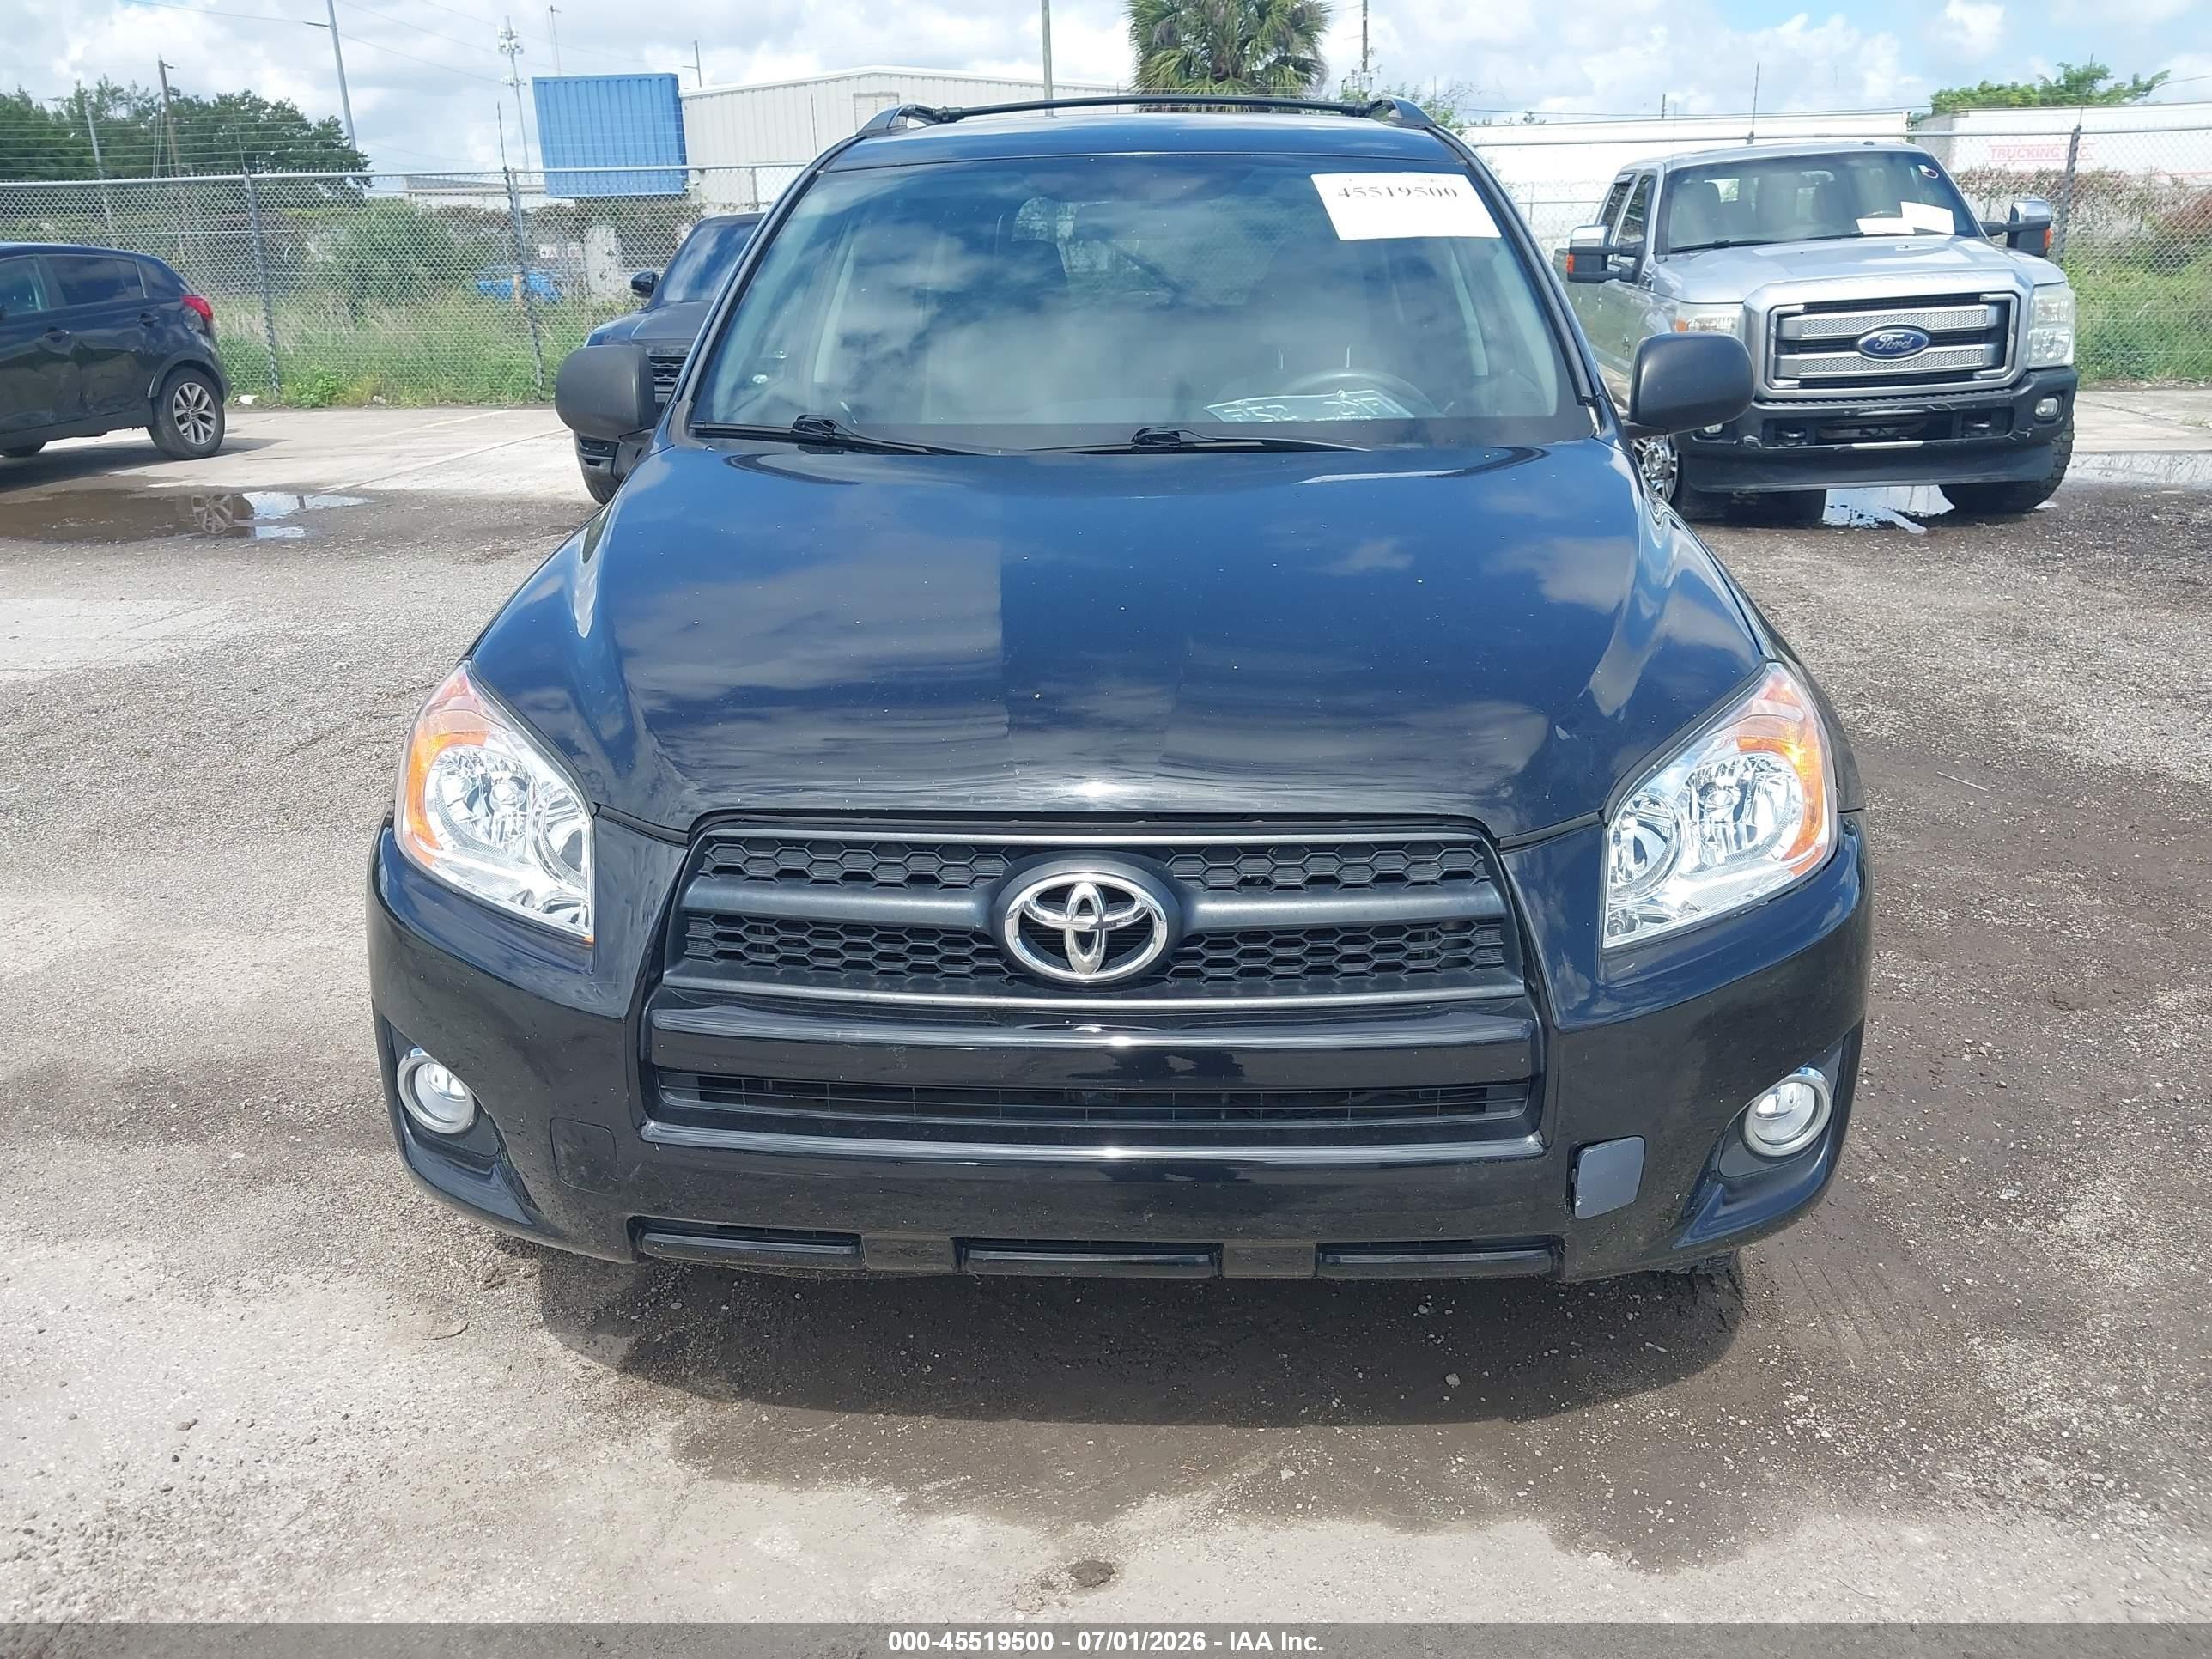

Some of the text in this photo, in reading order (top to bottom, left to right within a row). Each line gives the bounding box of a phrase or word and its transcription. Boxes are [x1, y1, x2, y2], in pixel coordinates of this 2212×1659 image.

[1990, 146, 2093, 159] TRUCKING IC.
[1338, 185, 1458, 198] 45519500
[1875, 333, 1914, 350] Ford
